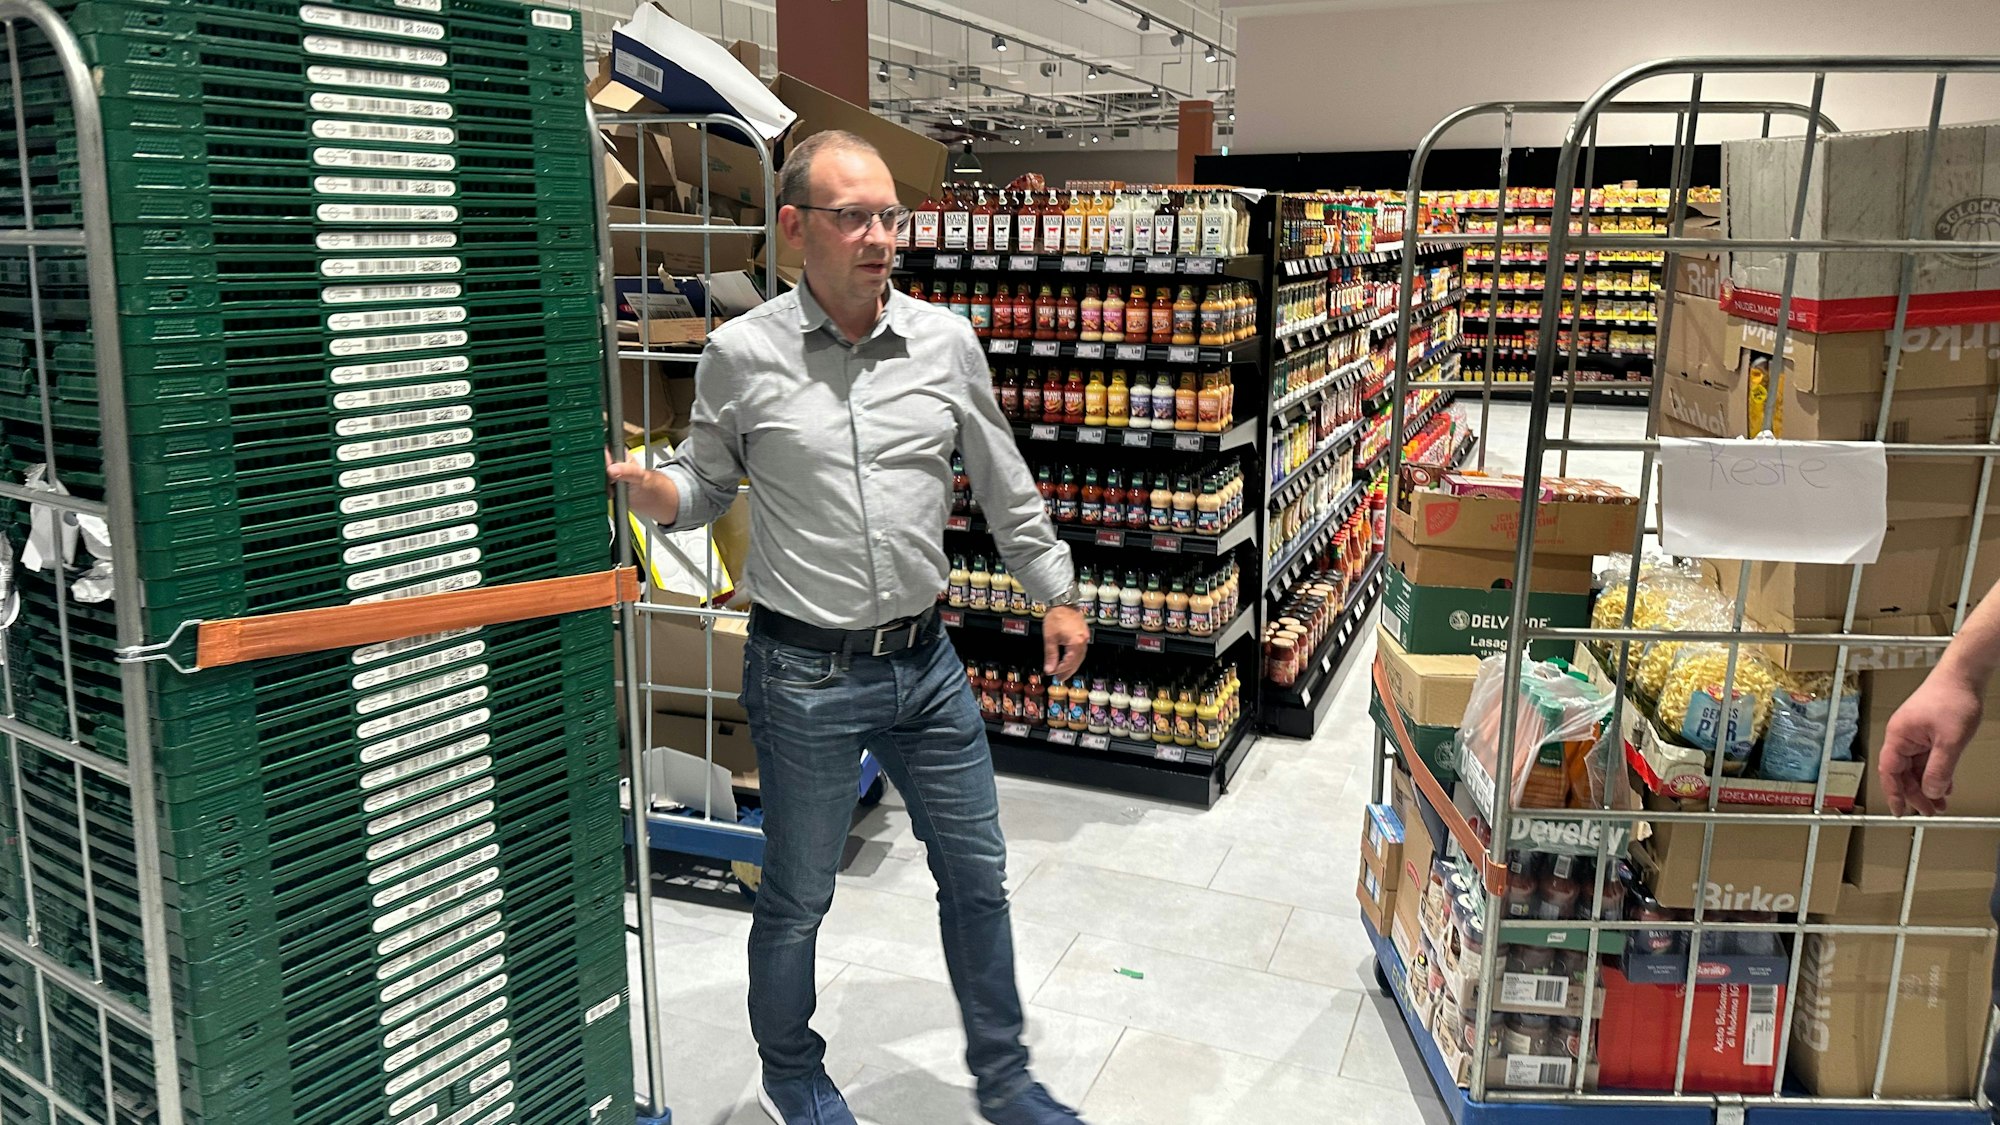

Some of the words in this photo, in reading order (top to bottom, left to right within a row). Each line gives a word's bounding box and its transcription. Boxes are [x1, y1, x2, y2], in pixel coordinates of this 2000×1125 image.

[1734, 300, 1796, 321] NUDELMACHEI
[1708, 441, 1830, 491] Reste
[1471, 613, 1550, 629] DELVDE
[1470, 635, 1508, 651] Lasag
[1726, 999, 1738, 1036] Modena
[1713, 1027, 1724, 1053] Aceto
[1725, 1038, 1735, 1048] di
